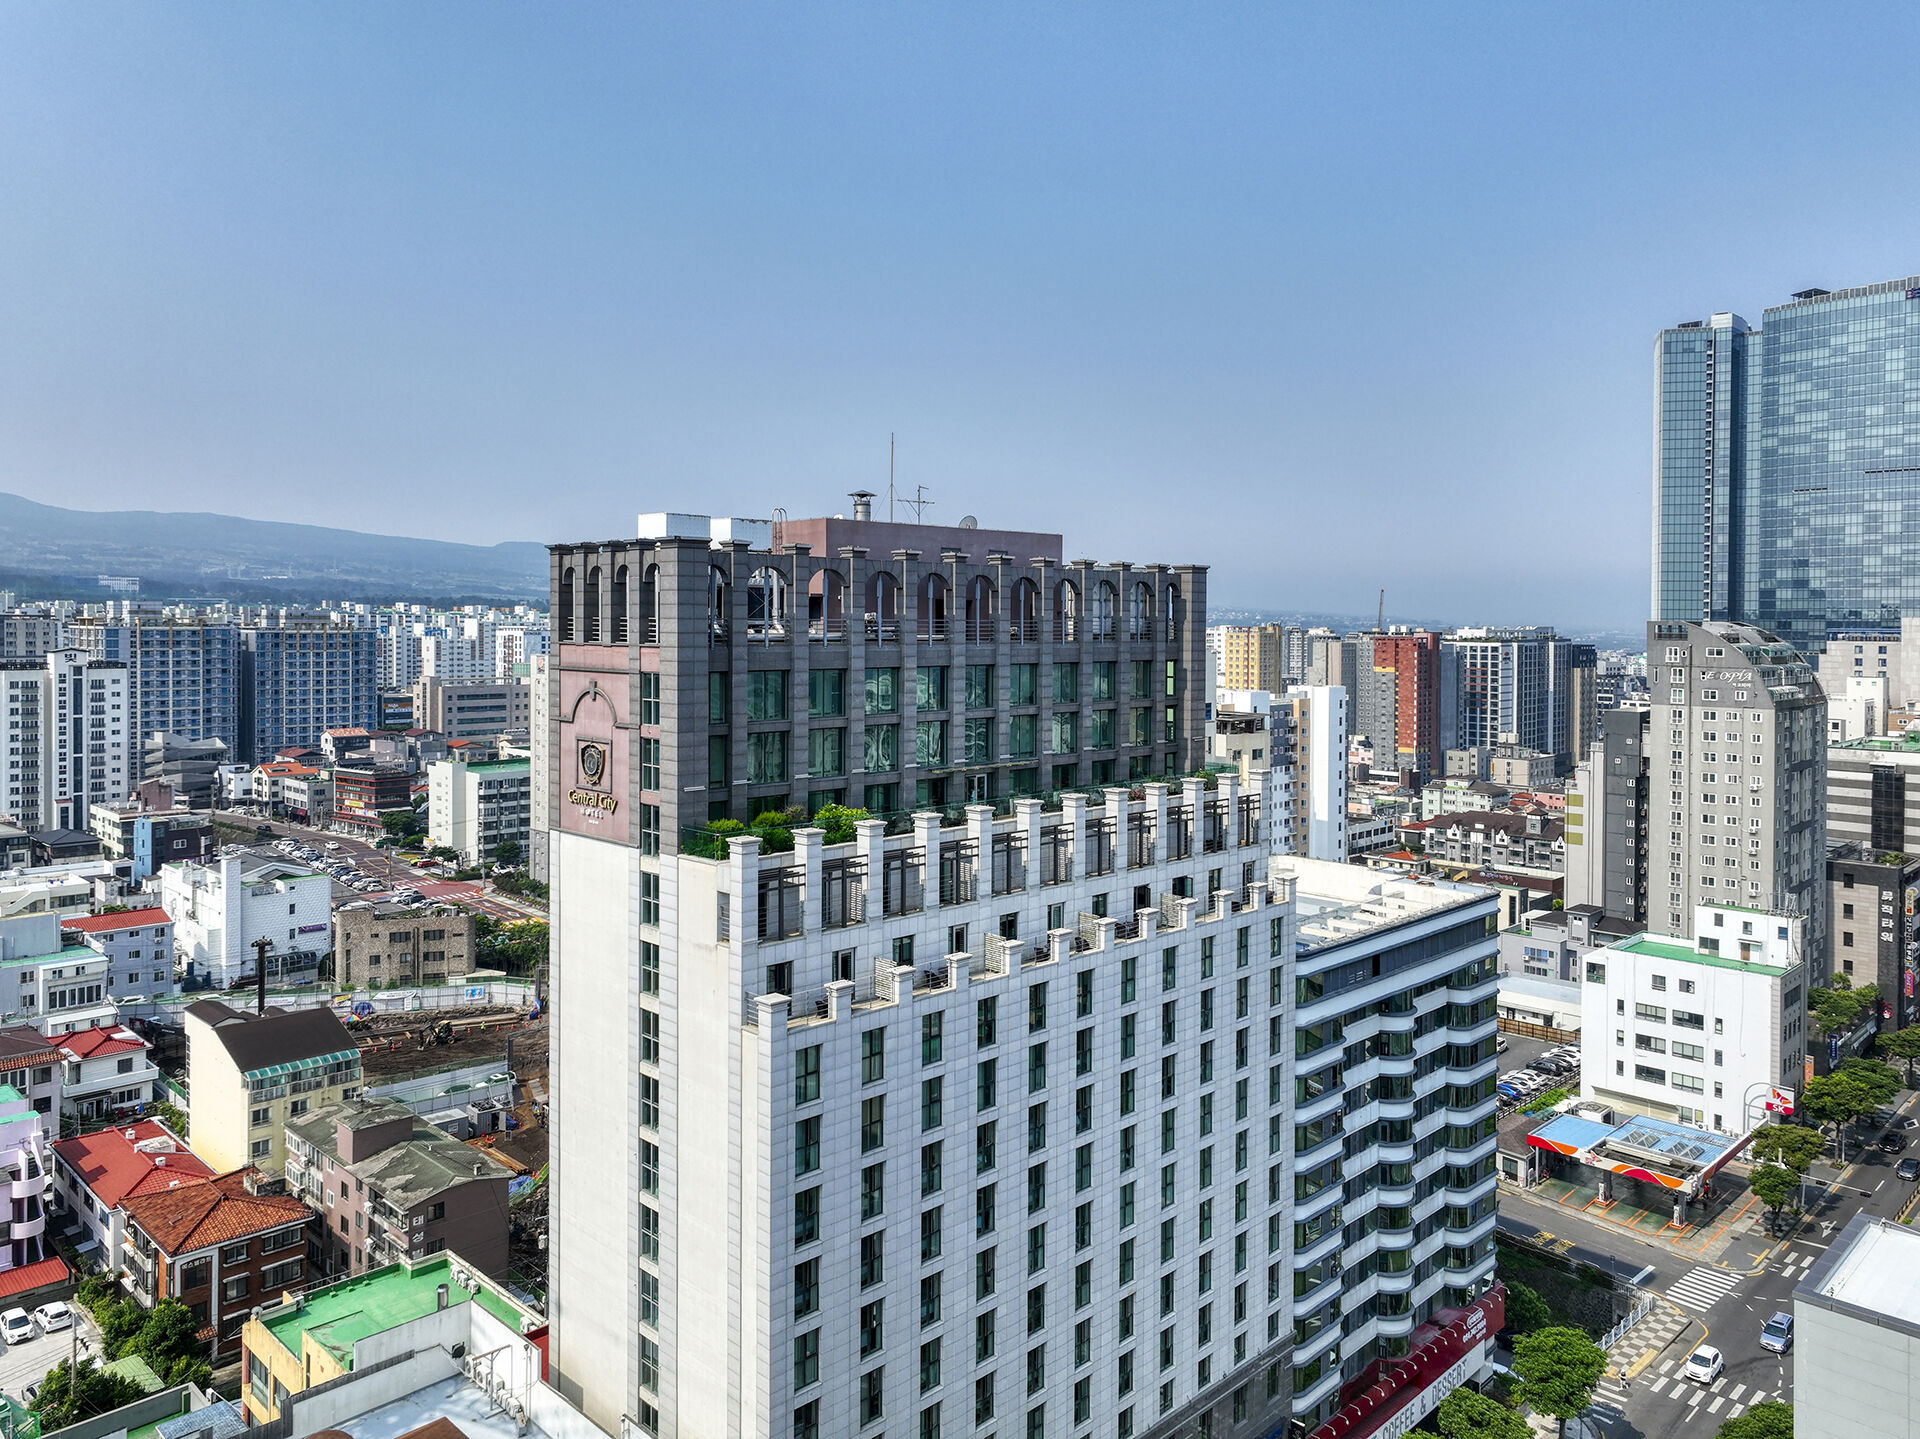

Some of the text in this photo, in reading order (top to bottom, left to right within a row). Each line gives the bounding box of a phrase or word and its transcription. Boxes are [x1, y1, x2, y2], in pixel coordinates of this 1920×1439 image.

[567, 789, 617, 813] Central City
[580, 808, 604, 818] HOTEL
[1772, 1104, 1785, 1114] SK
[1420, 1395, 1427, 1415] &
[1432, 1358, 1467, 1406] DESSERT
